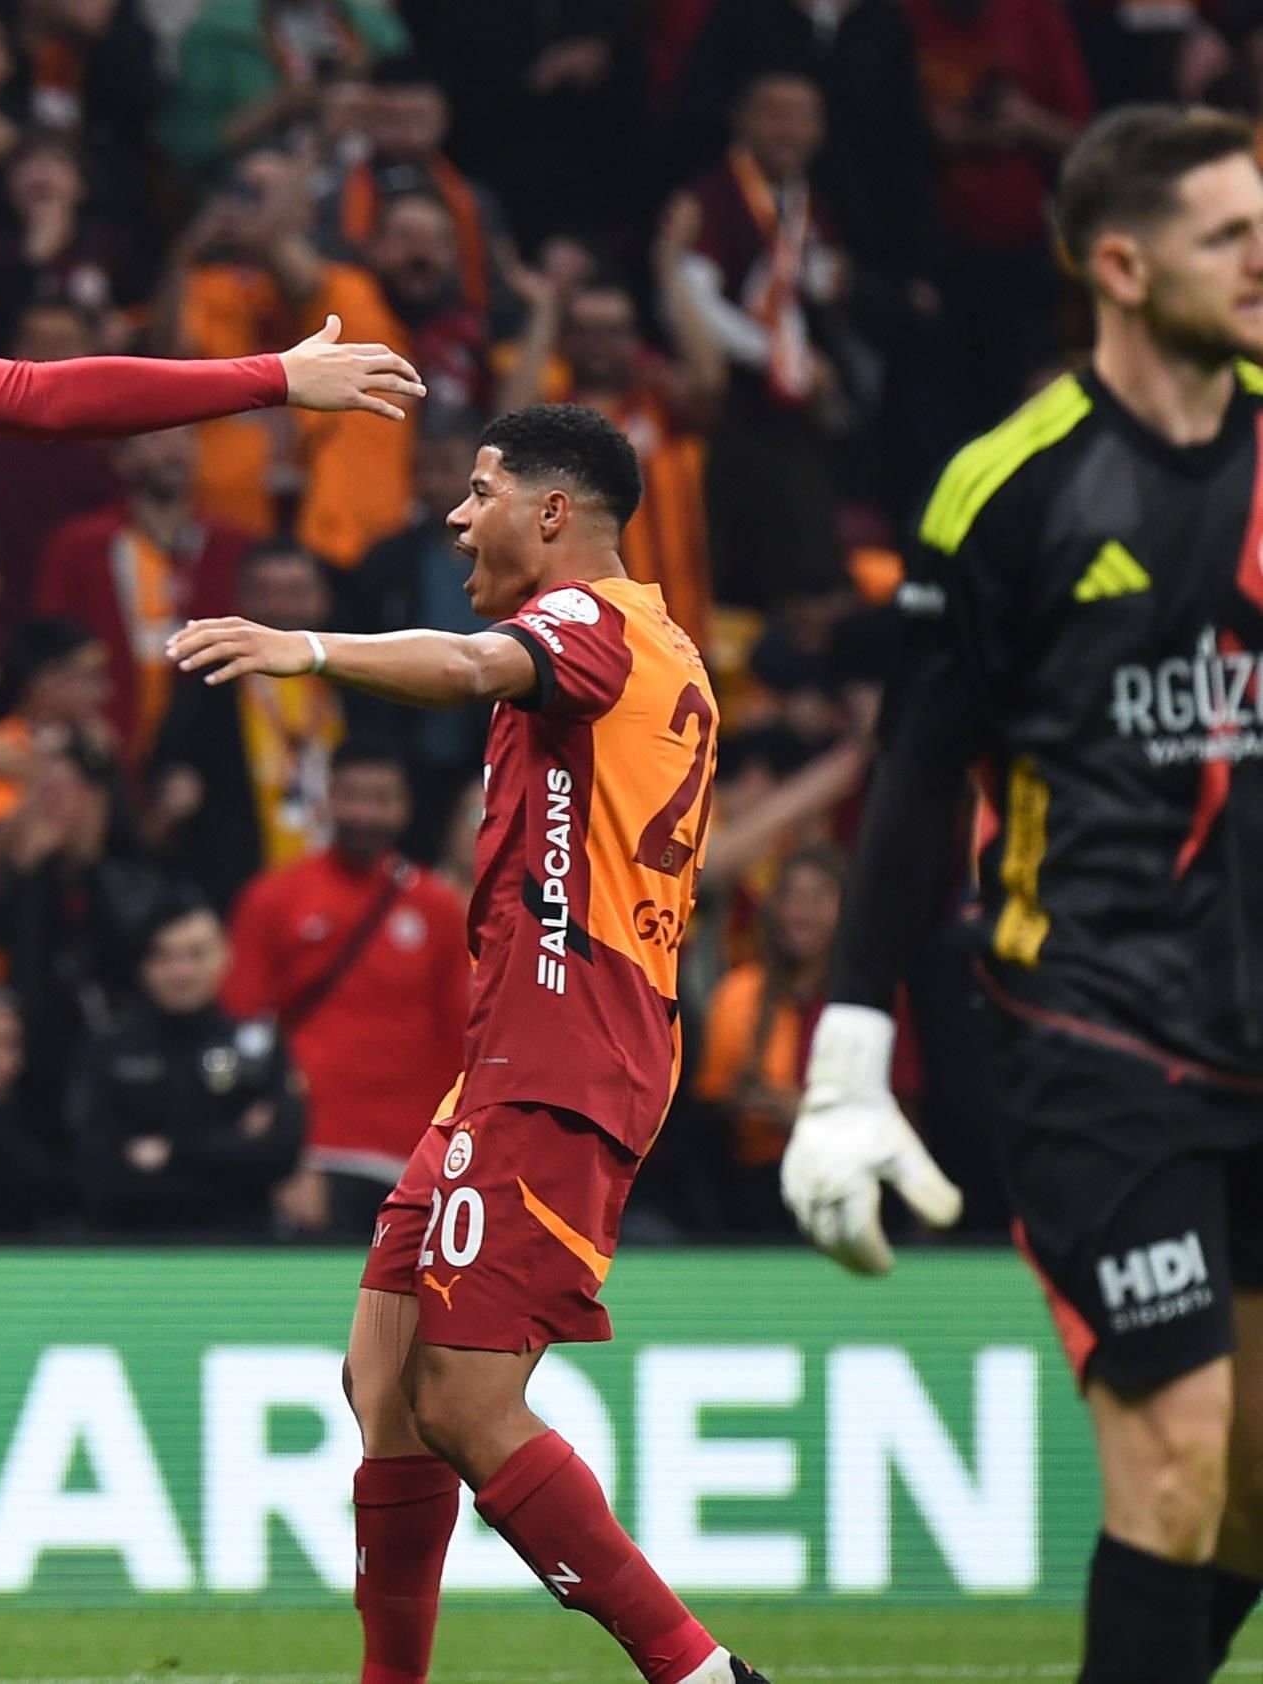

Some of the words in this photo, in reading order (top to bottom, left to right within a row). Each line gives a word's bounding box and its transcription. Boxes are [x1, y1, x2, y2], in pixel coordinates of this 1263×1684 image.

[539, 767, 573, 958] ALPCANS
[632, 681, 717, 879] 2
[1096, 1231, 1208, 1307] HDI
